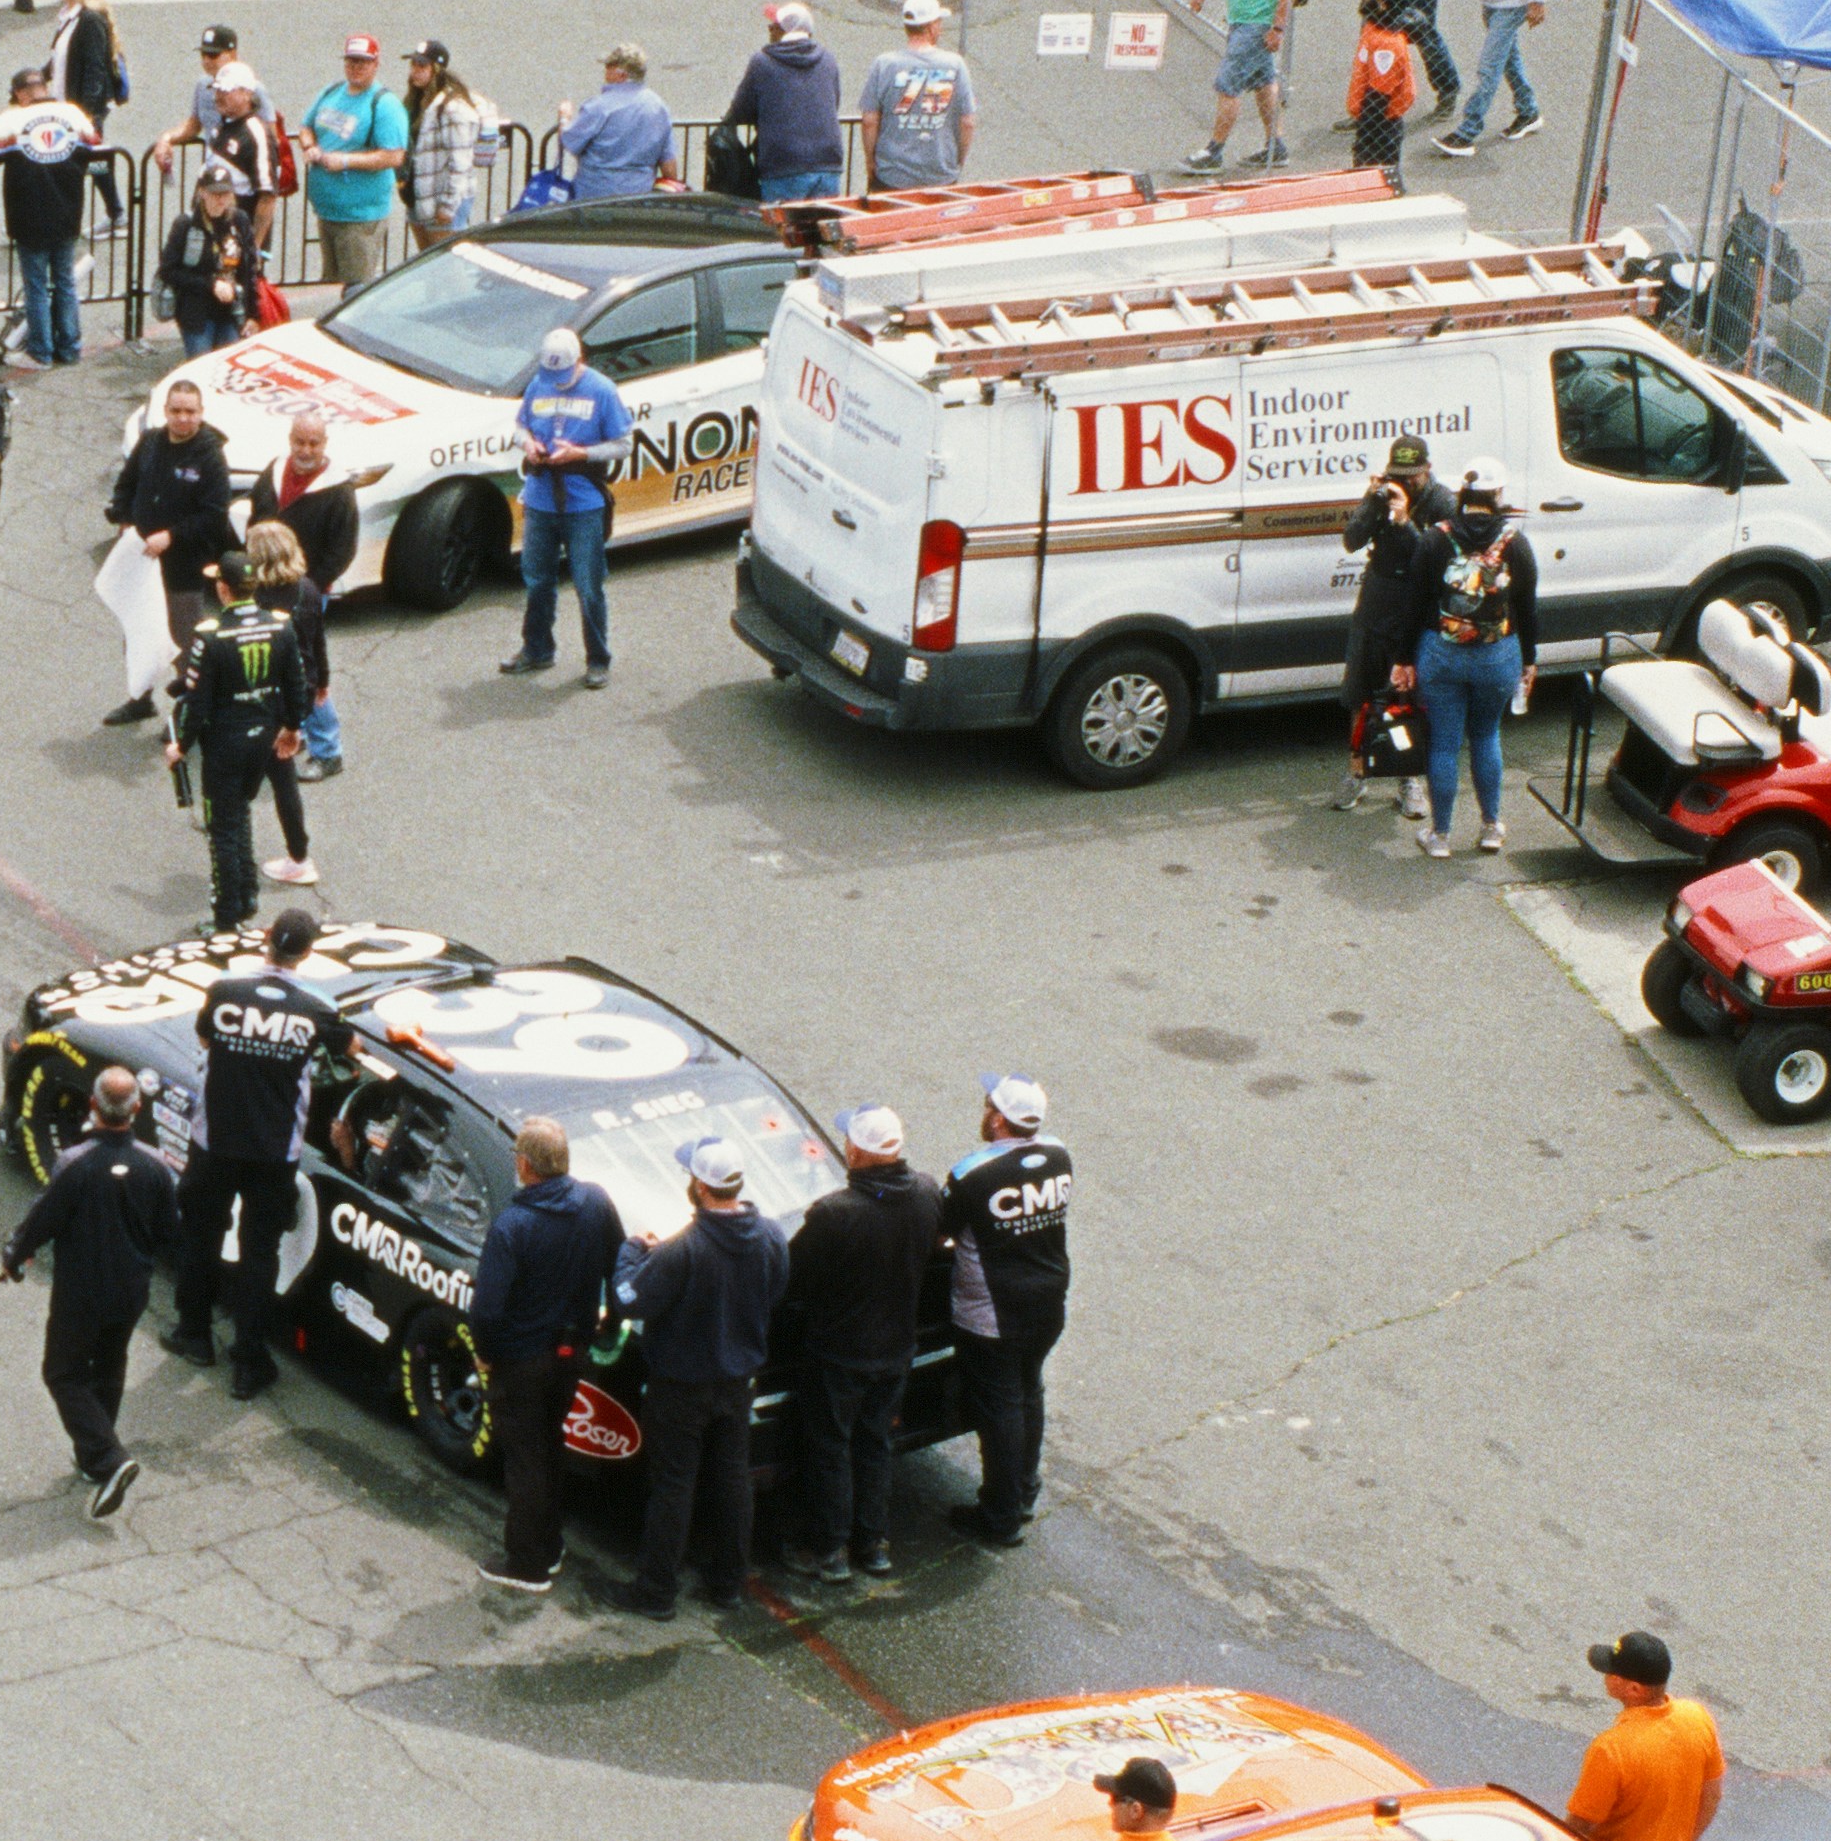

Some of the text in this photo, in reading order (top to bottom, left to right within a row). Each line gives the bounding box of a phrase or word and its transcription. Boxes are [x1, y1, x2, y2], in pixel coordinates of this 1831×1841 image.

[1131, 23, 1146, 43] NO
[893, 68, 957, 115] 75
[797, 357, 841, 422] IES
[1248, 387, 1350, 417] Indoor
[1066, 392, 1238, 497] IES
[1249, 405, 1471, 450] Environmental
[430, 430, 520, 469] OFFICIA
[1245, 450, 1368, 482] Services
[672, 459, 751, 502] RACE
[1262, 511, 1337, 528] Commercial
[1741, 527, 1752, 545] 5
[902, 624, 911, 642] 5
[213, 1003, 317, 1047] CMR
[632, 1090, 706, 1121] SIEG
